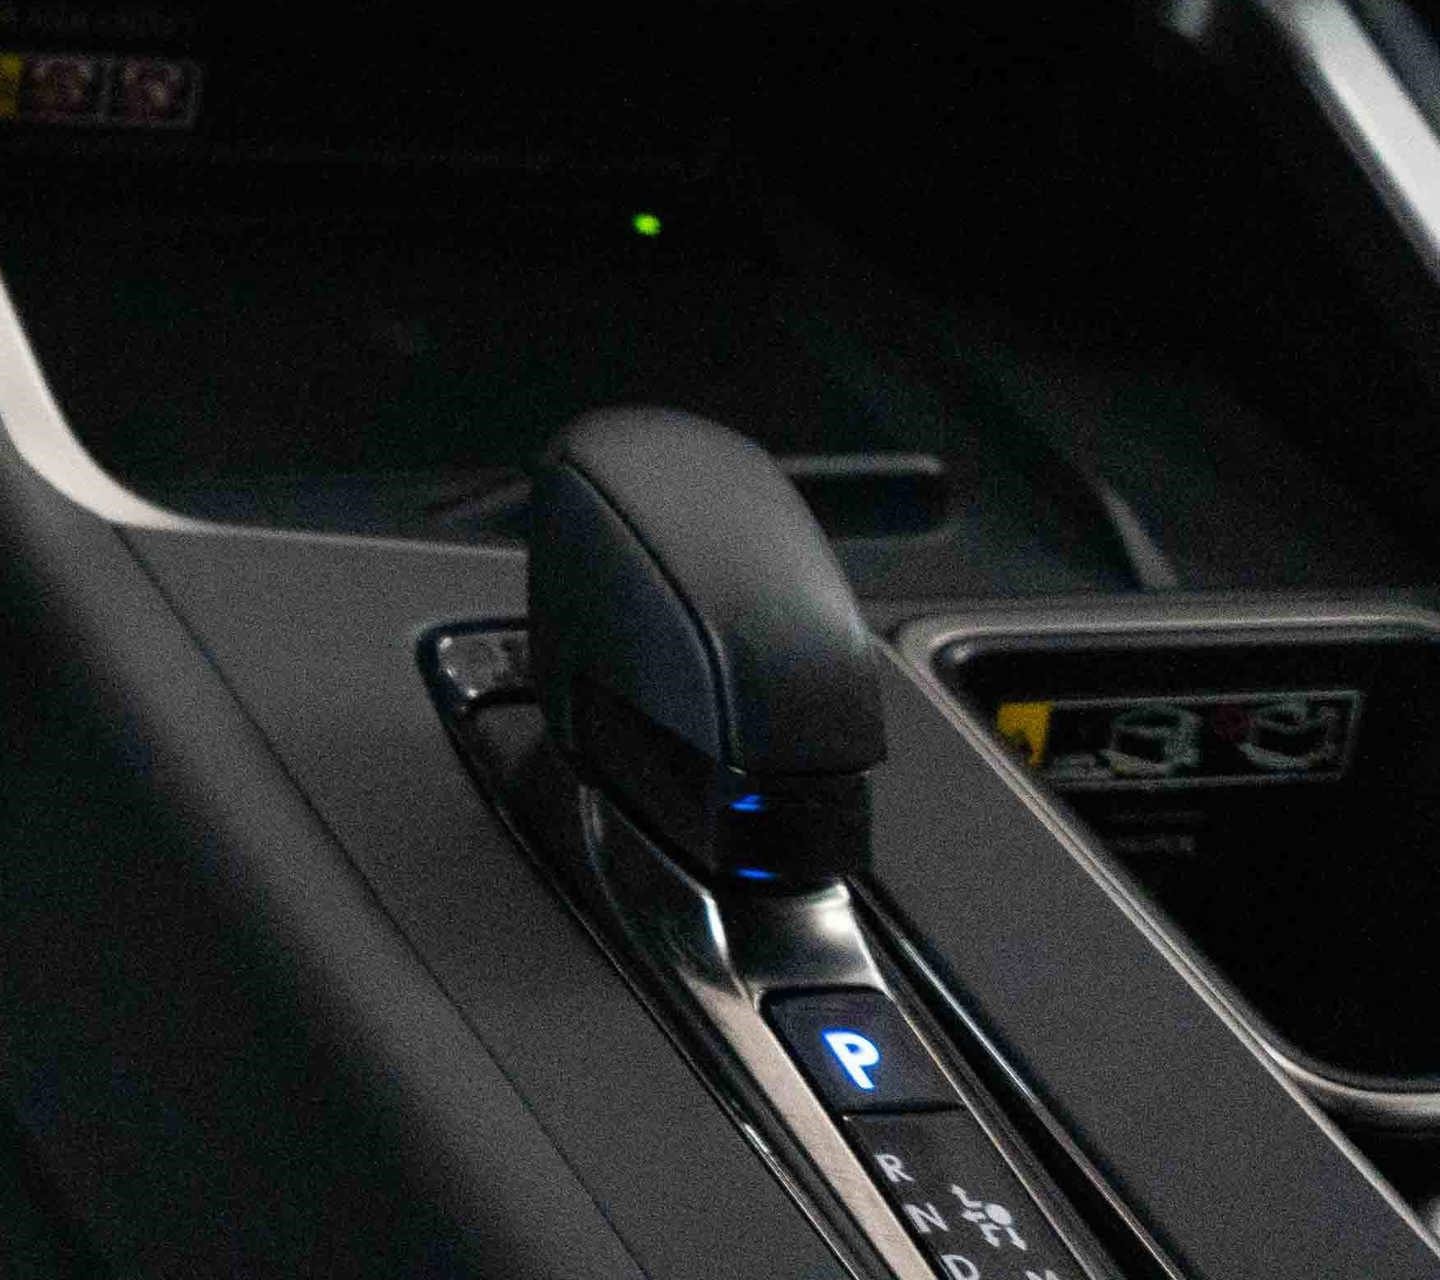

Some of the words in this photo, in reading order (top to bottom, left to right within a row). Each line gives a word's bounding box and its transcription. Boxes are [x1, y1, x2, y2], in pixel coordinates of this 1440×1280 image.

[822, 1030, 879, 1090] P
[875, 1152, 915, 1183] R
[902, 1201, 950, 1233] N
